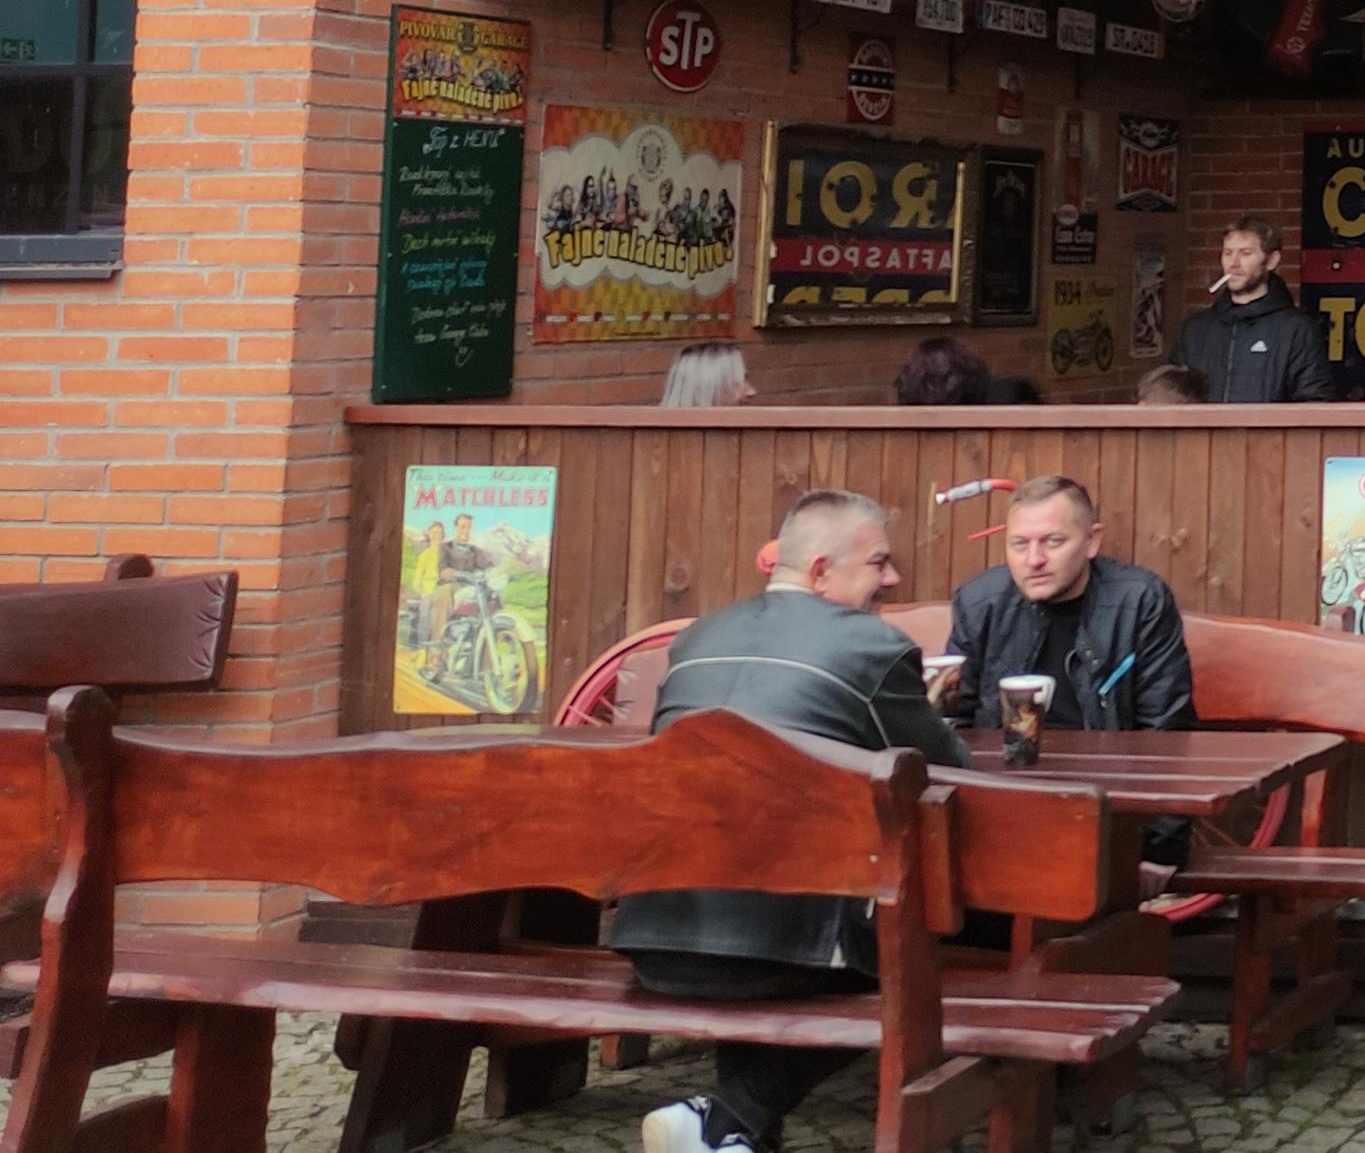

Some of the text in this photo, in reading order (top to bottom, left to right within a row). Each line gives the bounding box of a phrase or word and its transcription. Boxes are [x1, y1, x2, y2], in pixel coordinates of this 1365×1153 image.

[400, 21, 458, 42] PIVOVAR
[659, 11, 714, 70] STP
[413, 485, 549, 510] MATCHLESS
